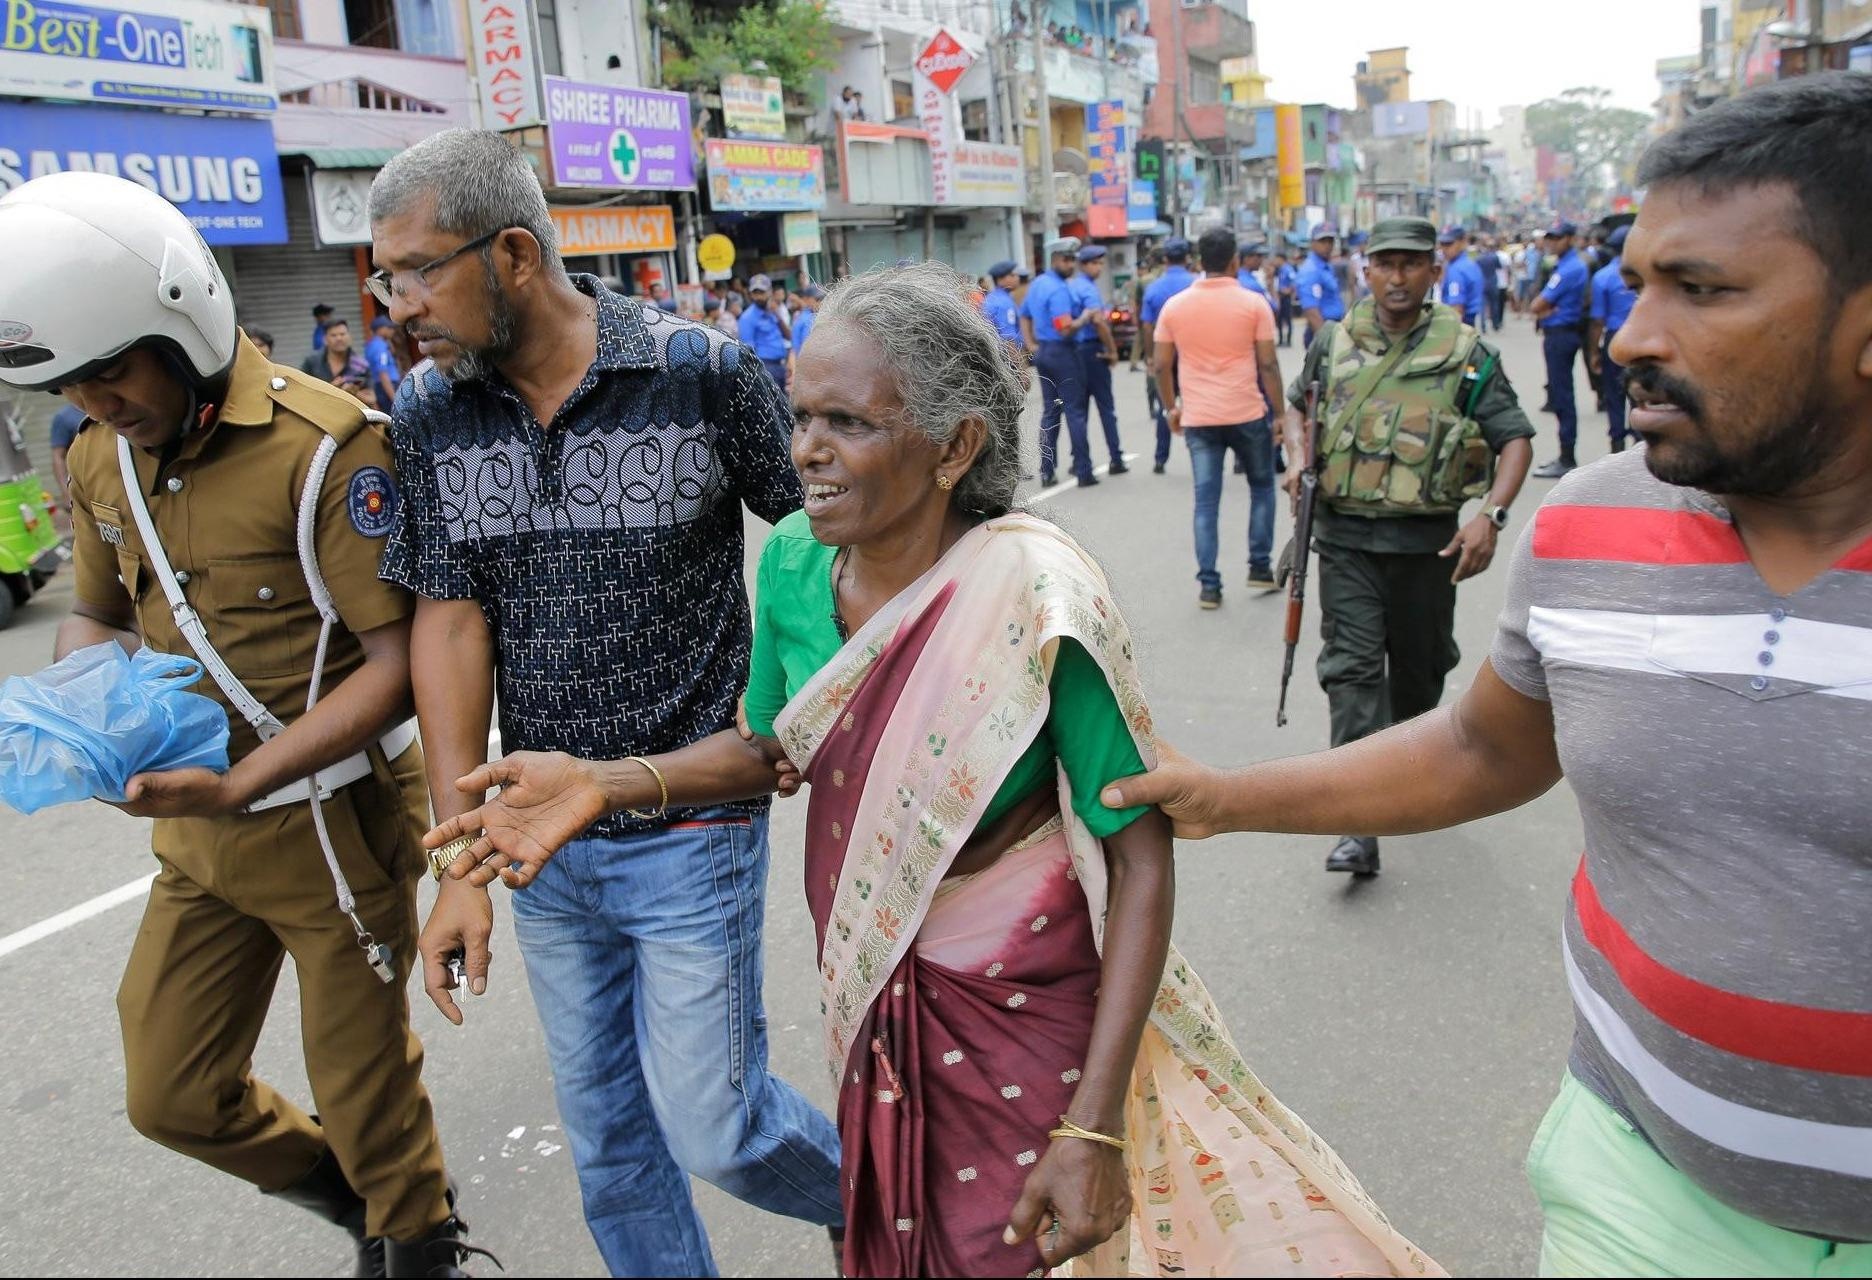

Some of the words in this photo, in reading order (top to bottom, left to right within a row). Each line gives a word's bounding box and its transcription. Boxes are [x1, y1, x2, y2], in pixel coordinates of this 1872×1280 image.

[481, 0, 524, 124] ARMACY
[550, 87, 611, 125] SHREE
[613, 94, 682, 131] PHARMA
[238, 216, 263, 229] TECH
